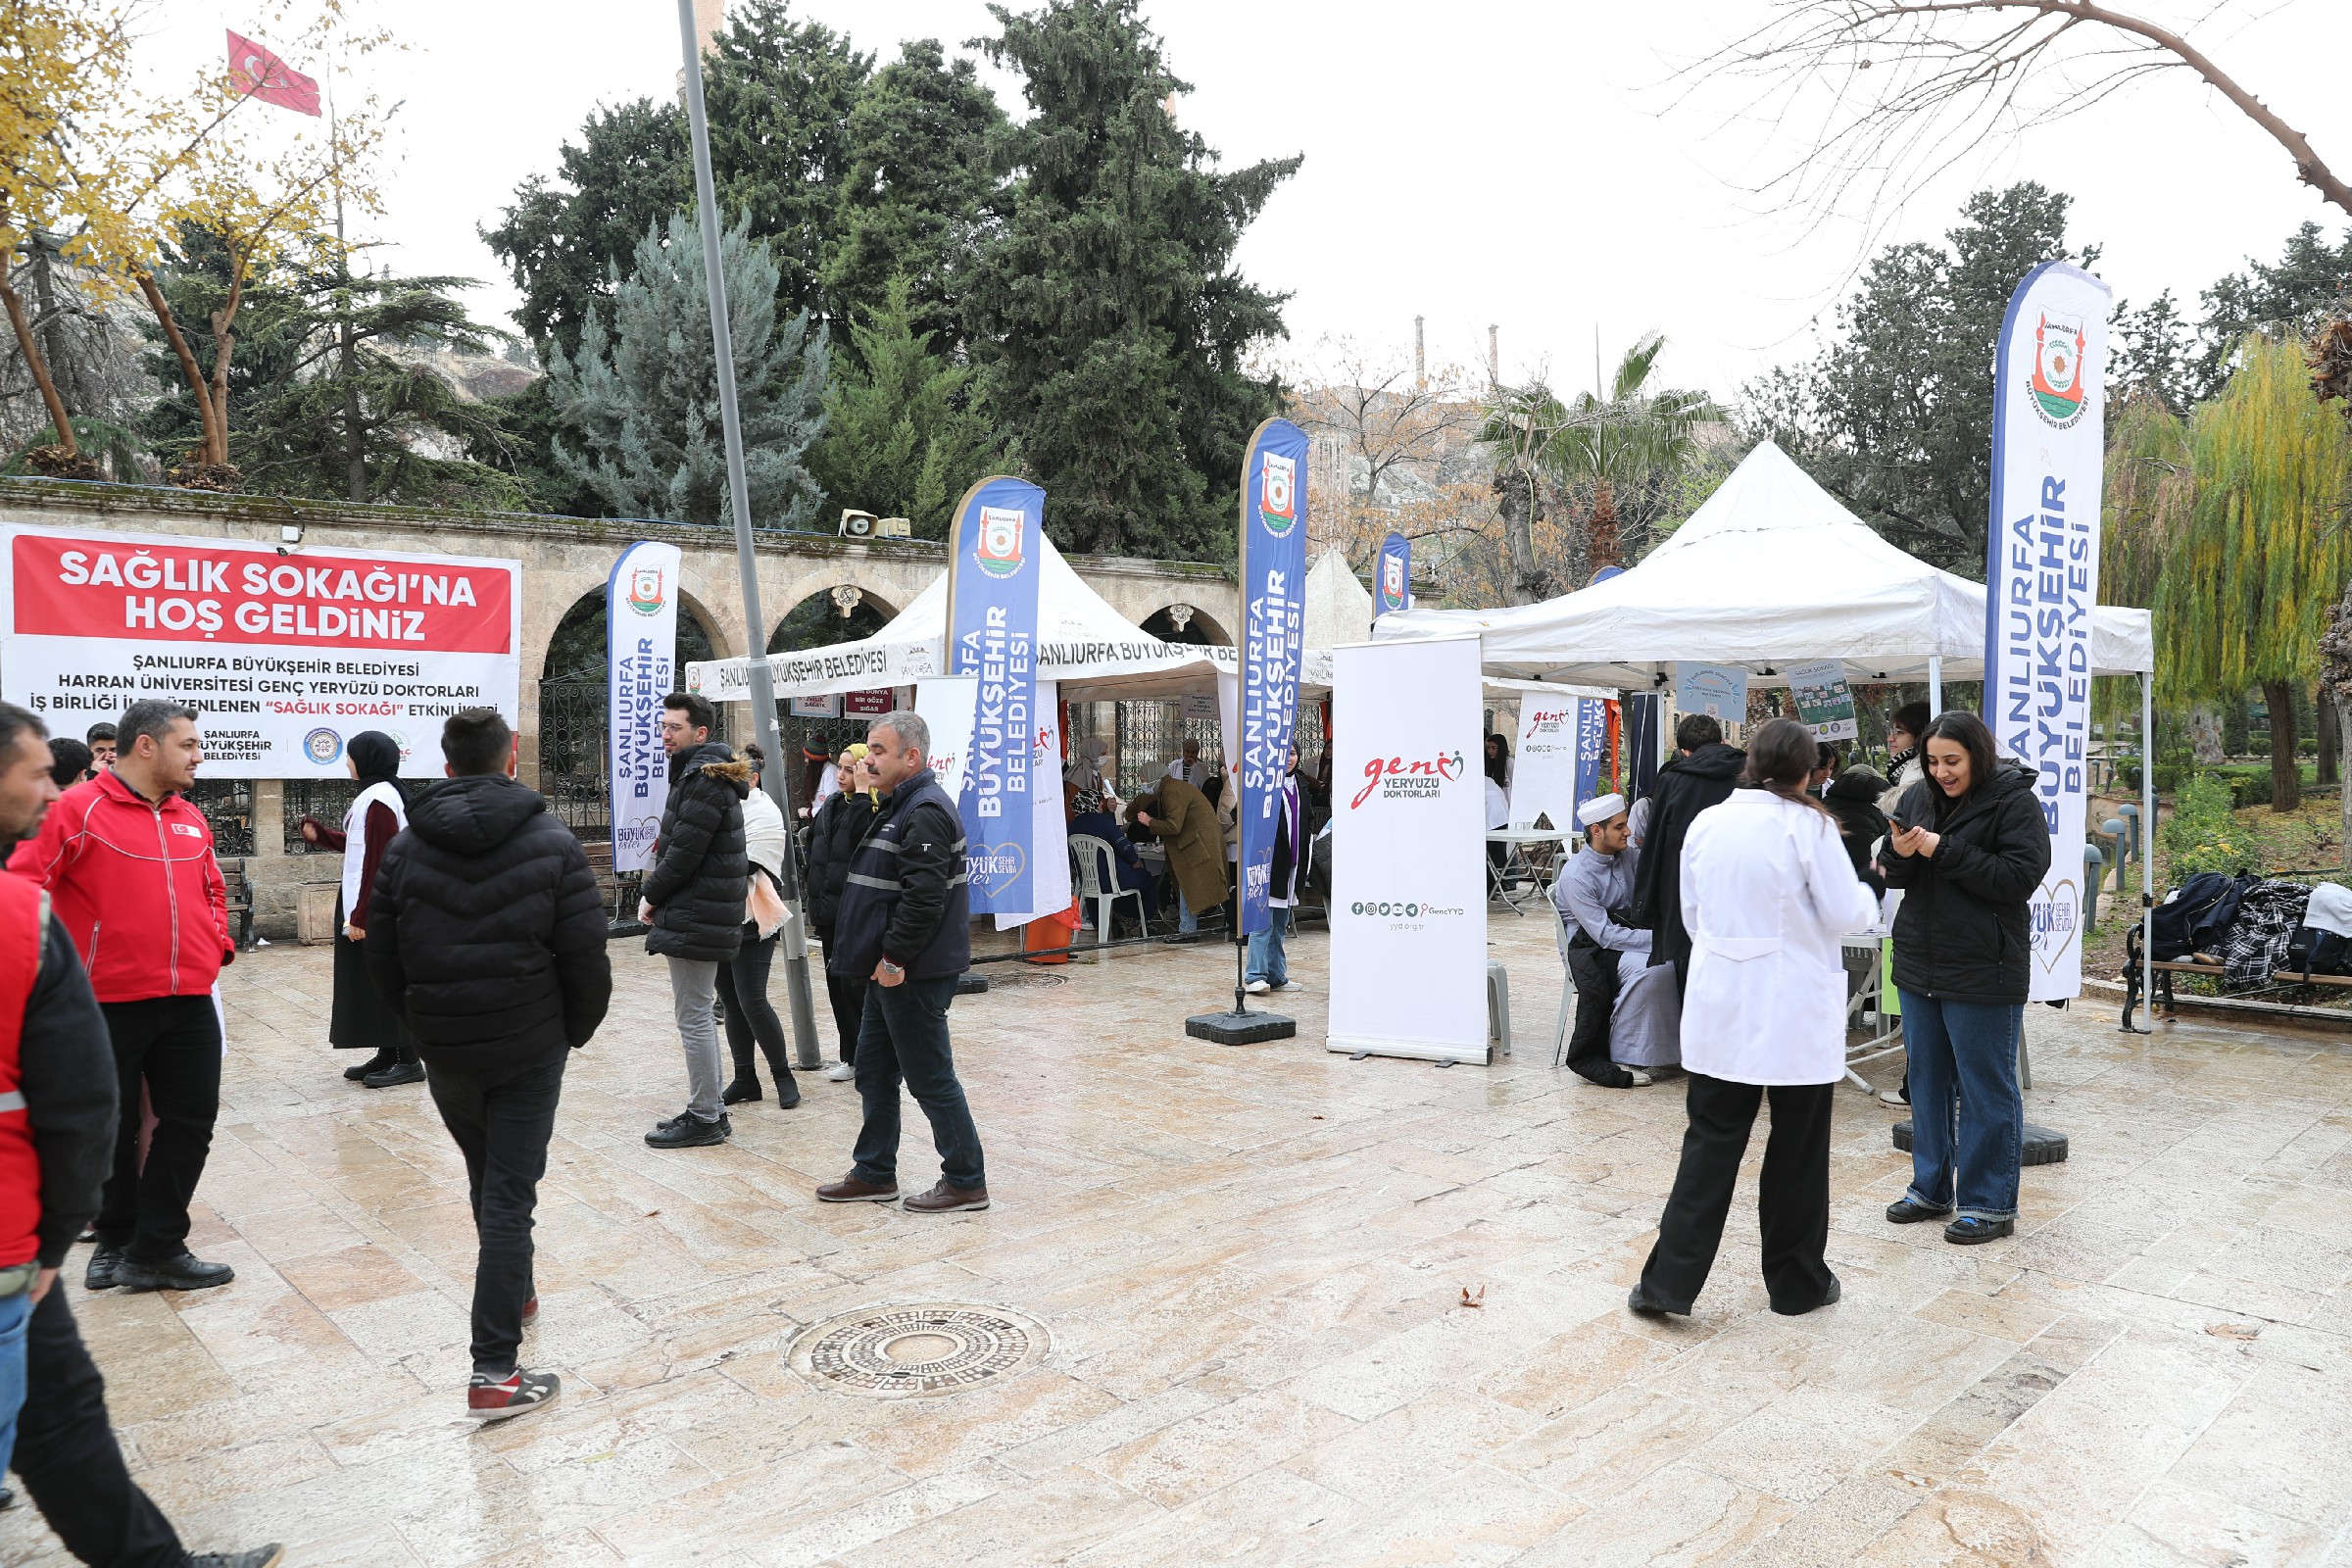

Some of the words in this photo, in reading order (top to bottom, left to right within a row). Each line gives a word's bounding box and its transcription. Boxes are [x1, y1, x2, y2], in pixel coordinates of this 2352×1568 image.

[59, 550, 231, 593] SAĞLIK
[125, 596, 223, 638] HOŞ
[234, 601, 425, 641] GELDİNİZ
[2008, 514, 2034, 762] ANLIURFA
[2037, 475, 2066, 835] BÜYÜKŞEHİR
[2065, 522, 2089, 794] BELEDİYESİ
[30, 692, 47, 711] İŞ
[53, 693, 118, 710] BİRLİĞİ
[59, 674, 135, 689] HARRAN
[140, 674, 253, 692] ÜNİVERSİTESİ
[258, 680, 304, 697] GENÇ
[309, 680, 378, 696] YERYÜZÜ
[382, 684, 479, 698] DOKTORLARI
[133, 655, 227, 671] ŞANLIURFA
[232, 657, 331, 676] BÜYÜKŞEHİR
[336, 661, 419, 676] BELEDİYESİ
[720, 666, 750, 692] ŞANLIU
[771, 655, 823, 686] ÜYÜKŞEHİR
[824, 645, 888, 680] BELEDİYESİ
[1245, 597, 1264, 789] ŞANLIURFA
[1262, 569, 1286, 819] BÜYÜKŞEHİR
[1275, 601, 1300, 789] BELEDİYESİ
[198, 741, 271, 752] ÜYÜKŞEHİR
[204, 730, 260, 739] ŞANLIURFA
[619, 656, 633, 779] ŞANLIURFA
[634, 637, 653, 798] BÜYÜKŞEHİR
[978, 606, 1007, 817] BÜYÜKŞEHİR
[1007, 632, 1029, 793] BELEDİYESİ
[1383, 777, 1440, 789] YERYÜZÜ
[1383, 790, 1441, 799] DOKTORLARI
